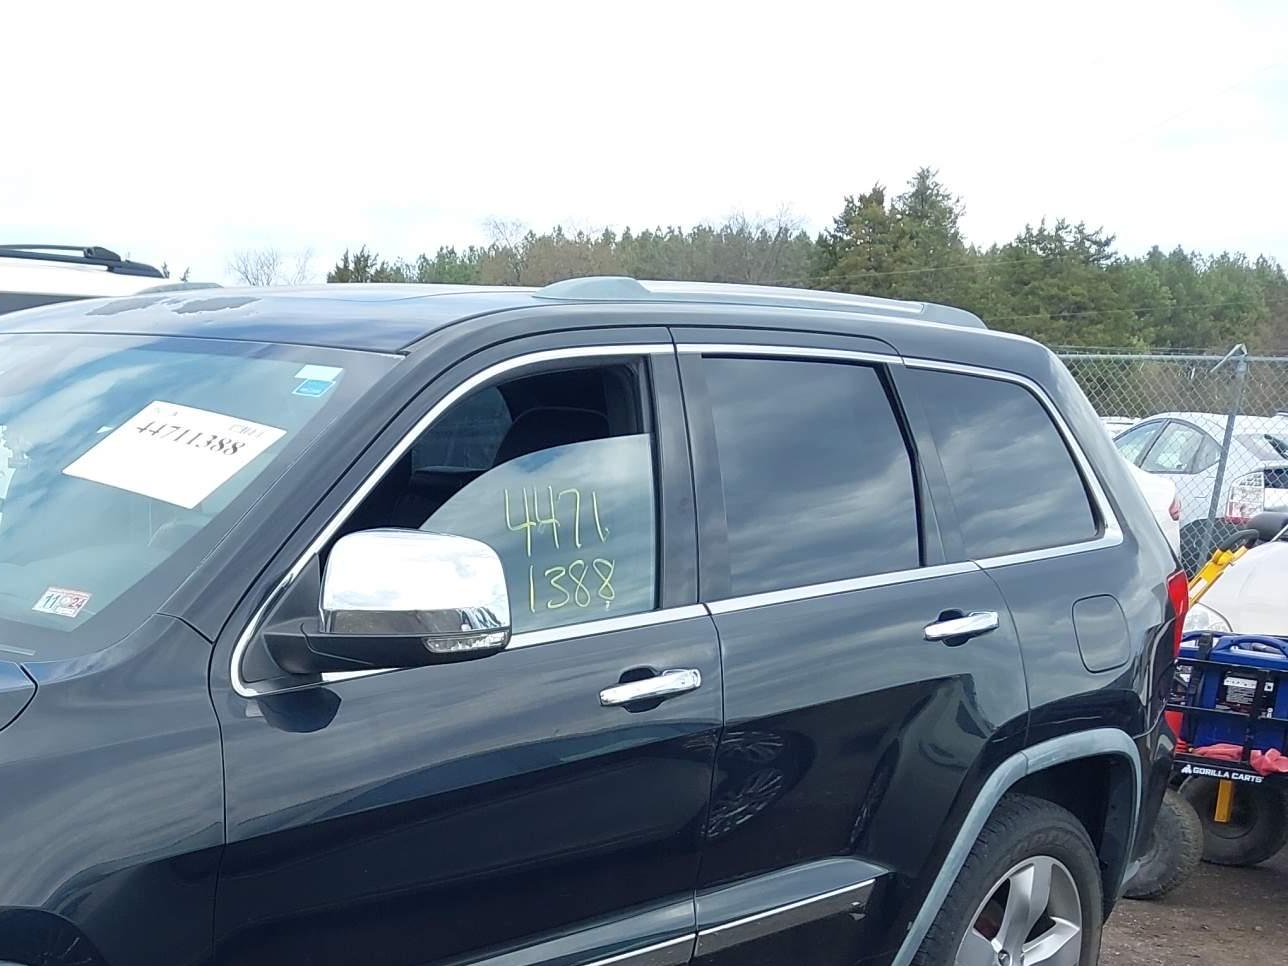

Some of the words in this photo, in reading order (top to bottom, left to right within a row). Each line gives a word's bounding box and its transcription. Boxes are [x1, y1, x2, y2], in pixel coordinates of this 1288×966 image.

[136, 421, 245, 456] 44711388
[504, 485, 609, 557] 4471
[529, 558, 615, 614] 1388
[1193, 766, 1230, 779] GORILLA
[1231, 772, 1264, 783] CARTS
